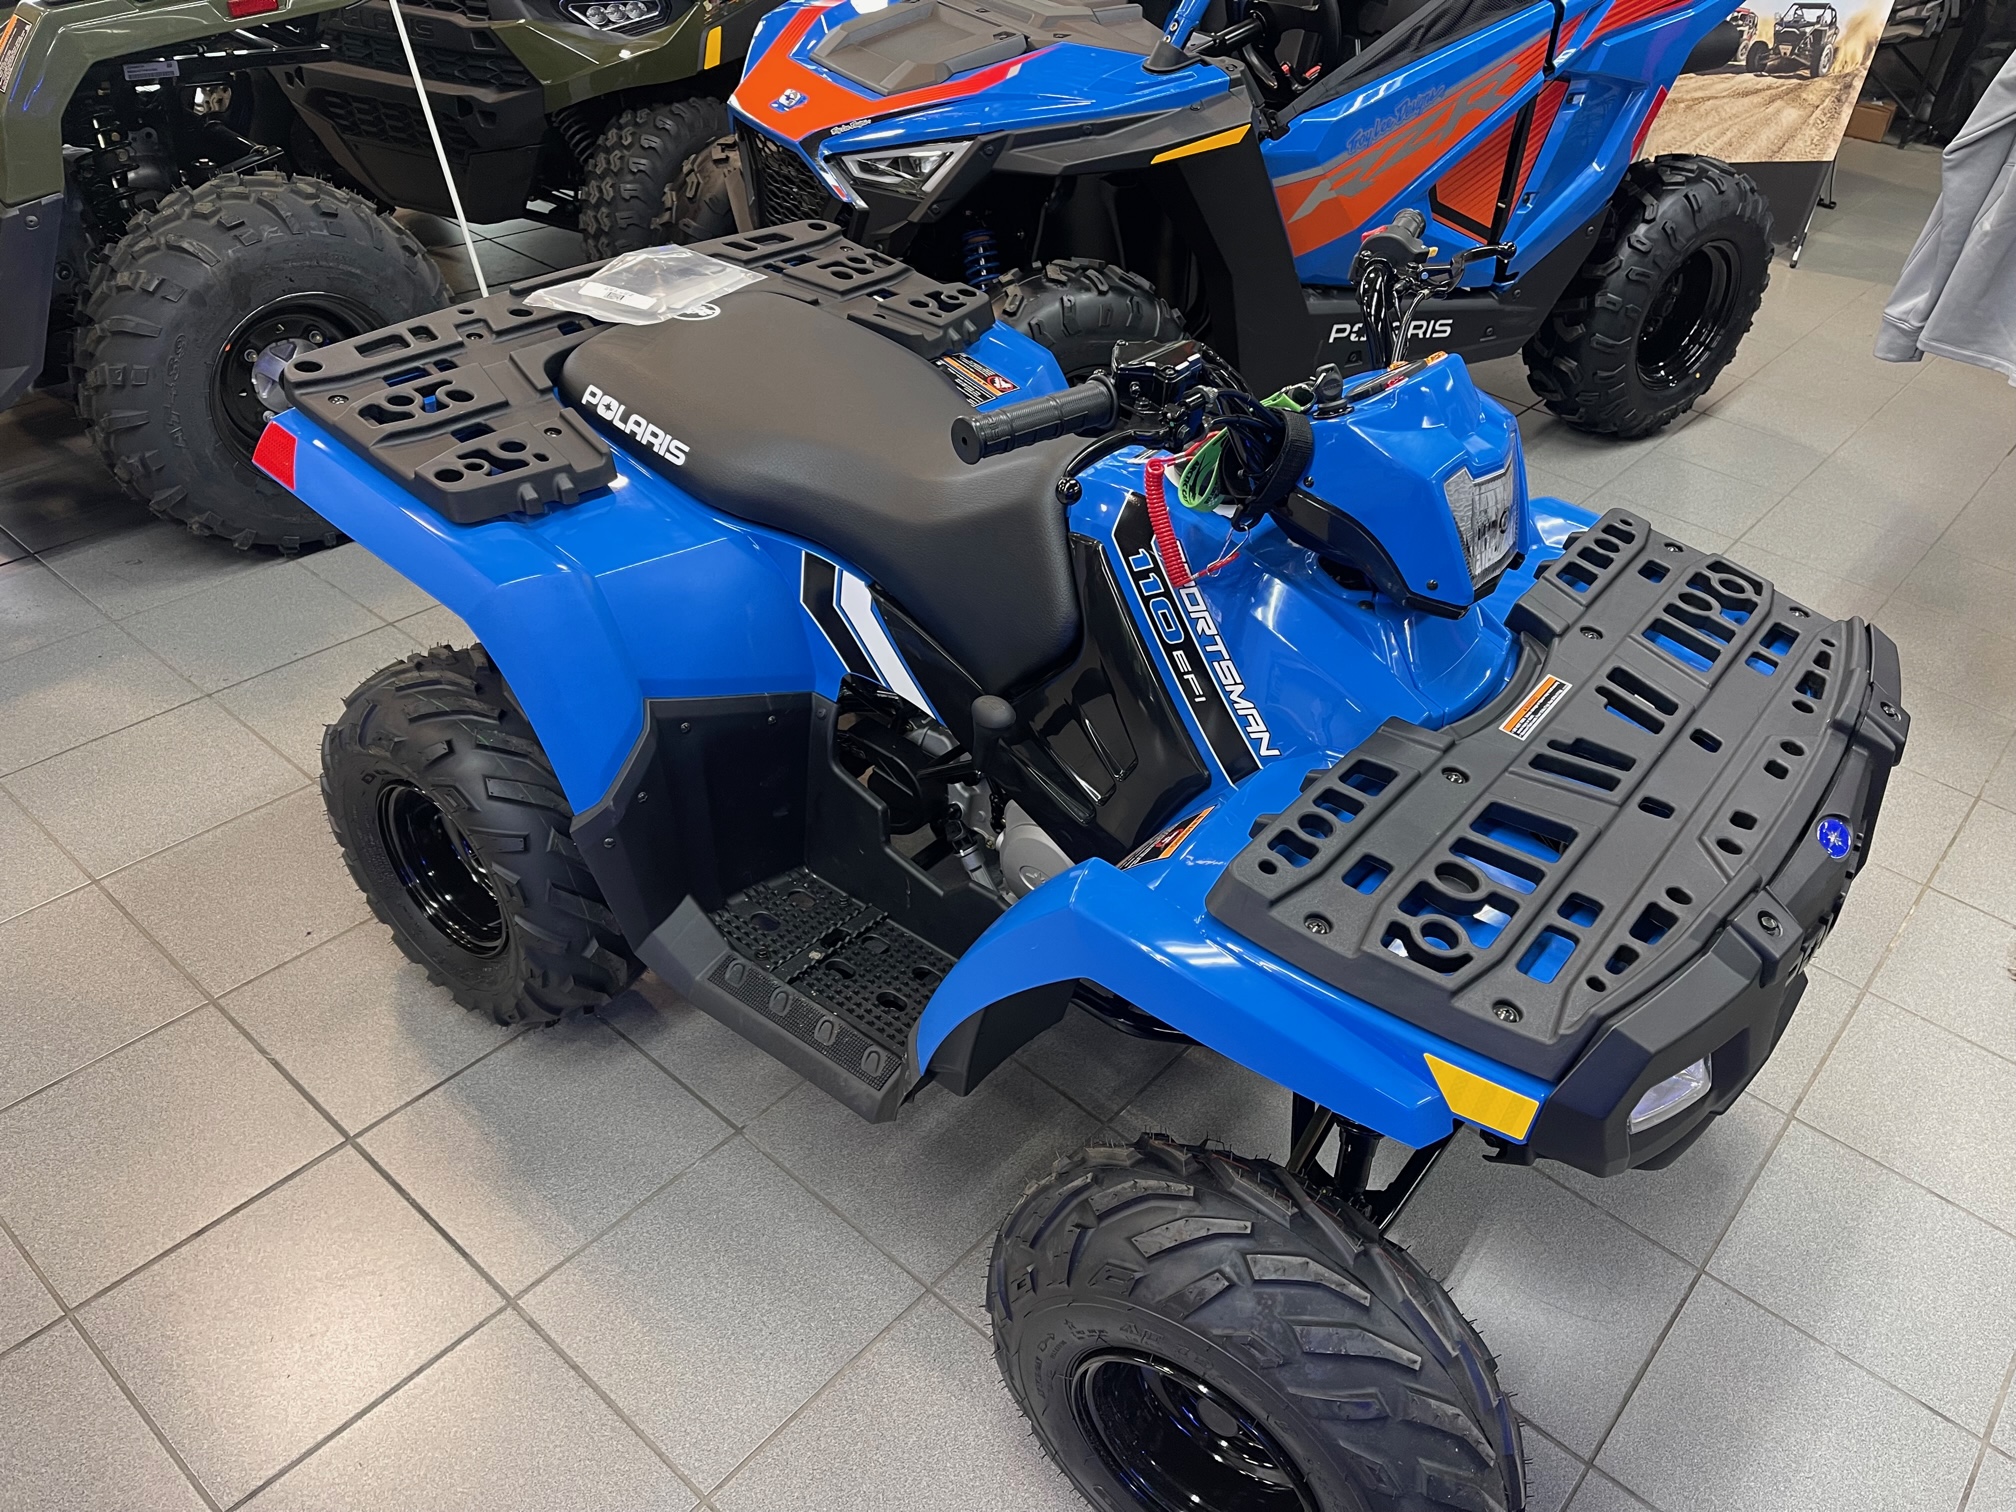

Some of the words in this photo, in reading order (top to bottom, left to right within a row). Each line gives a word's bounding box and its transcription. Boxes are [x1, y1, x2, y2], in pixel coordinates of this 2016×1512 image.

[1328, 319, 1453, 343] PORIS
[581, 384, 690, 466] POLARIS
[1129, 548, 1184, 644] 110
[1172, 650, 1206, 703] EFI
[1176, 538, 1281, 757] ORTSMAN
